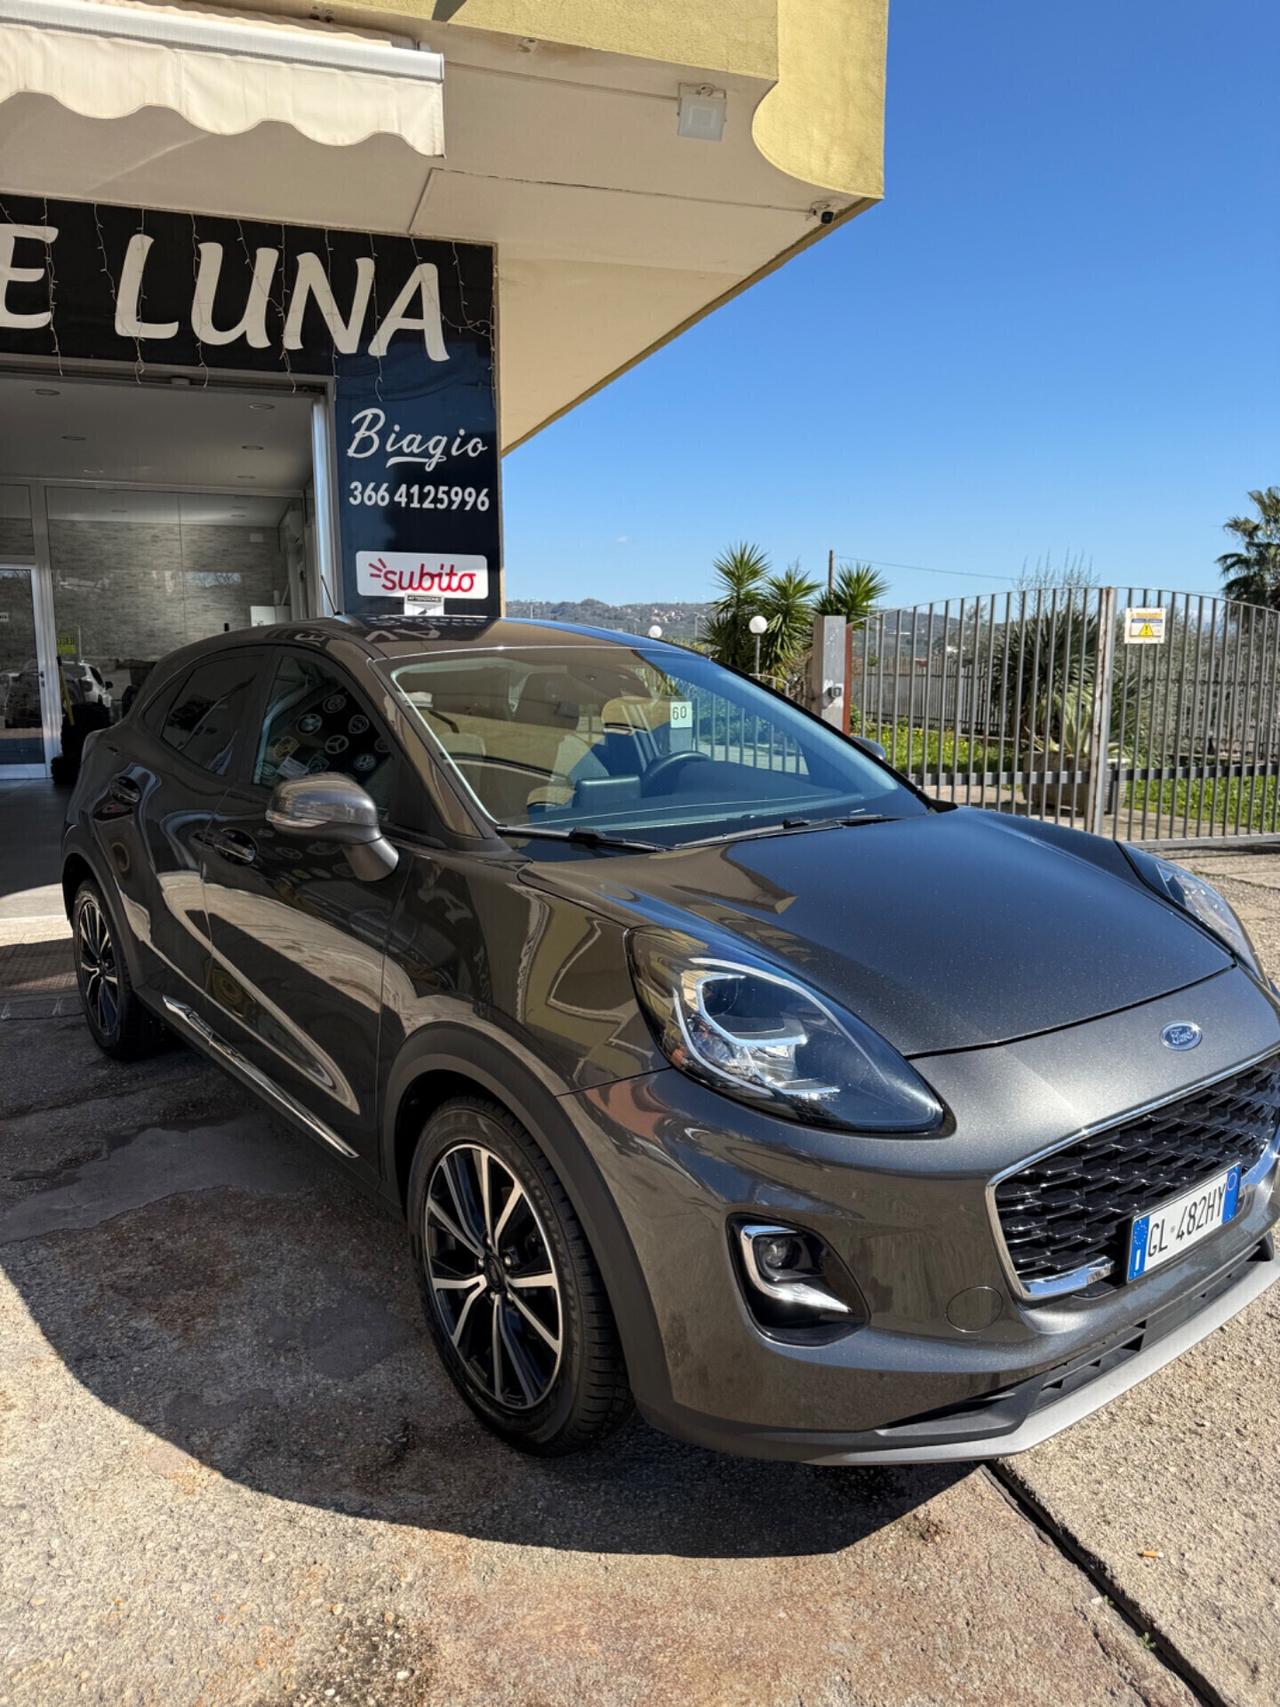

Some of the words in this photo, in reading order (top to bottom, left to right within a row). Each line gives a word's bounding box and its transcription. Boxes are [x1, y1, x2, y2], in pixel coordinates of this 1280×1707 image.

[114, 233, 451, 362] LUNA
[346, 407, 488, 472] Biagio
[348, 481, 390, 507] 366
[393, 483, 490, 511] 4125996
[381, 563, 476, 592] subito
[672, 705, 687, 720] 60
[1147, 1218, 1168, 1257] GL
[1175, 1183, 1226, 1241] 482HY
